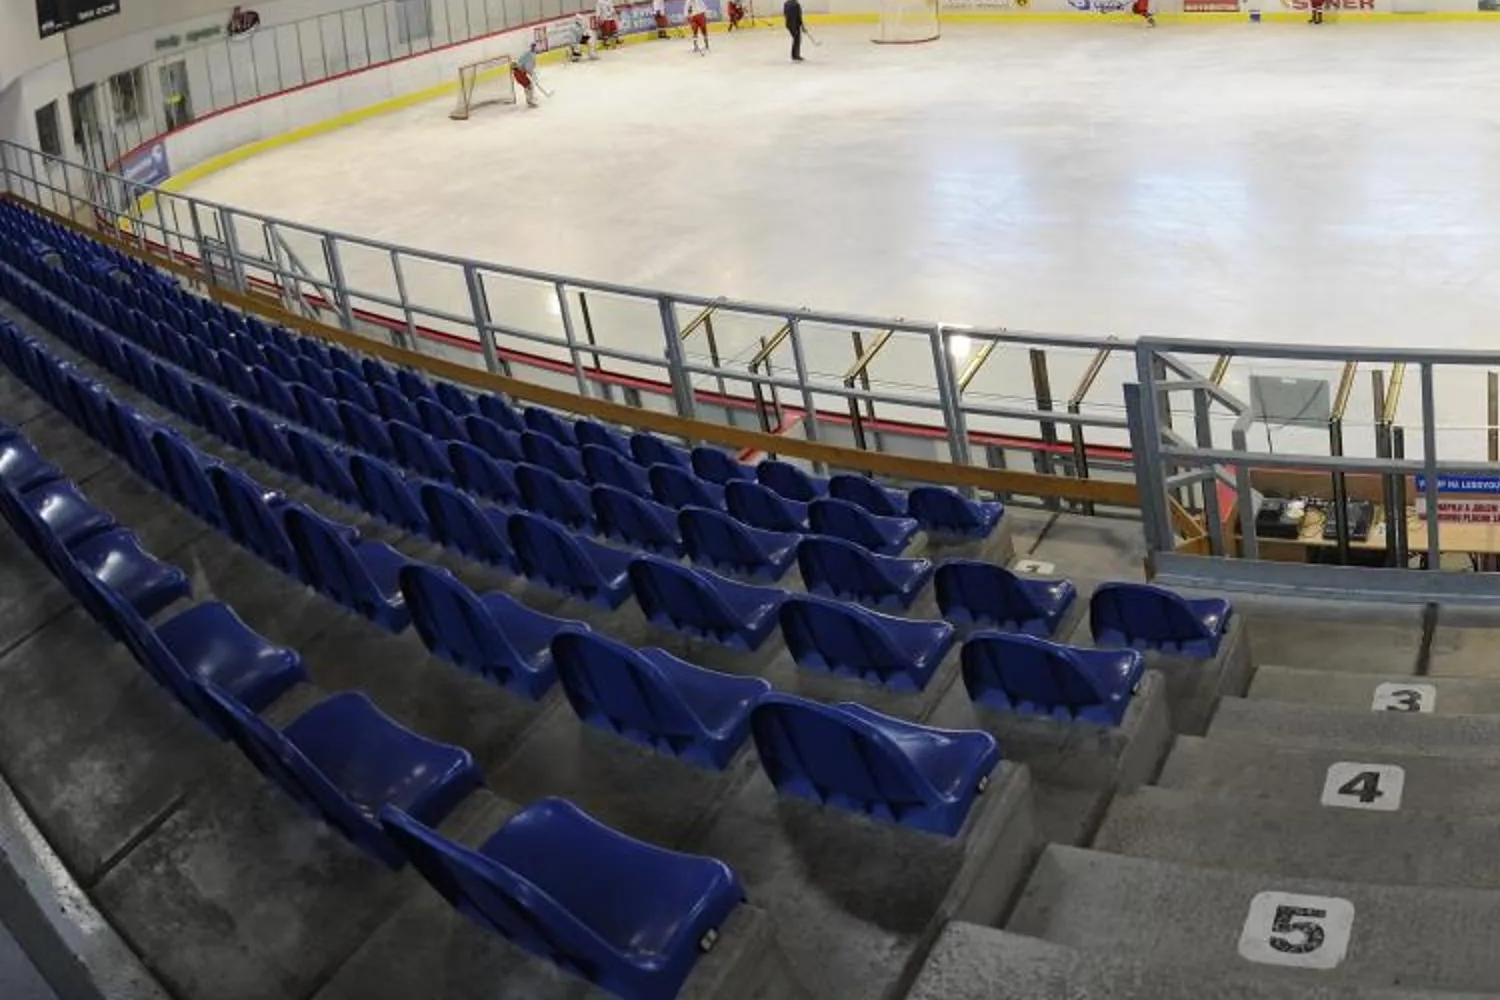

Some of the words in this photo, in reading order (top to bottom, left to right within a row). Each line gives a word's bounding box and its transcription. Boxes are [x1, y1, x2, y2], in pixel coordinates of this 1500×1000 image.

[1386, 689, 1422, 712] 3
[1338, 771, 1384, 803] 4
[1269, 905, 1327, 954] 5
